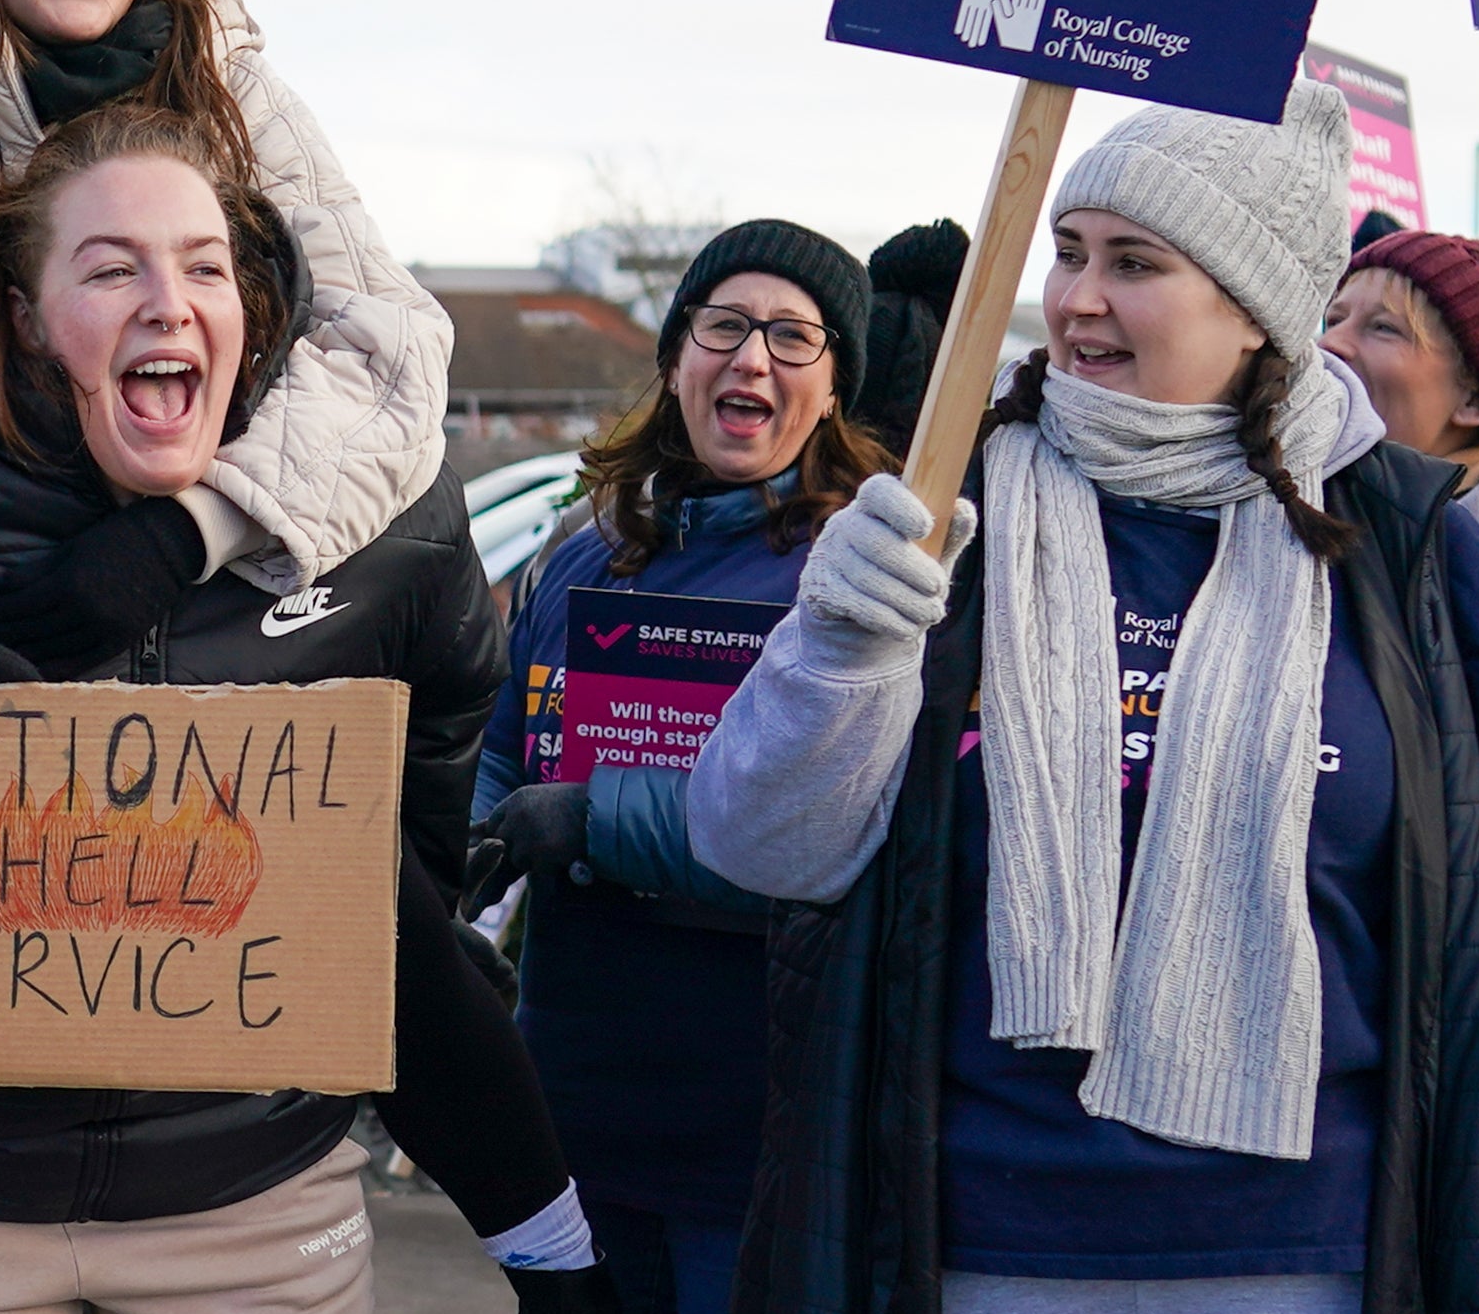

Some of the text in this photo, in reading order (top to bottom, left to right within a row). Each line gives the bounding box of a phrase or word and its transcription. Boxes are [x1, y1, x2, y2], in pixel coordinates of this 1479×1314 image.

[1053, 7, 1190, 55] Royal College
[1044, 36, 1151, 80] of Nursing
[274, 586, 333, 614] NIKE
[638, 624, 687, 643] SAFE
[1124, 611, 1177, 632] Royal
[1120, 631, 1144, 644] of
[638, 642, 753, 663] SAVES LIVES
[610, 701, 717, 727] Will there
[576, 723, 712, 748] enough staf
[595, 747, 634, 764] you
[0, 833, 215, 908] HELL
[298, 1208, 365, 1256] new balanc
